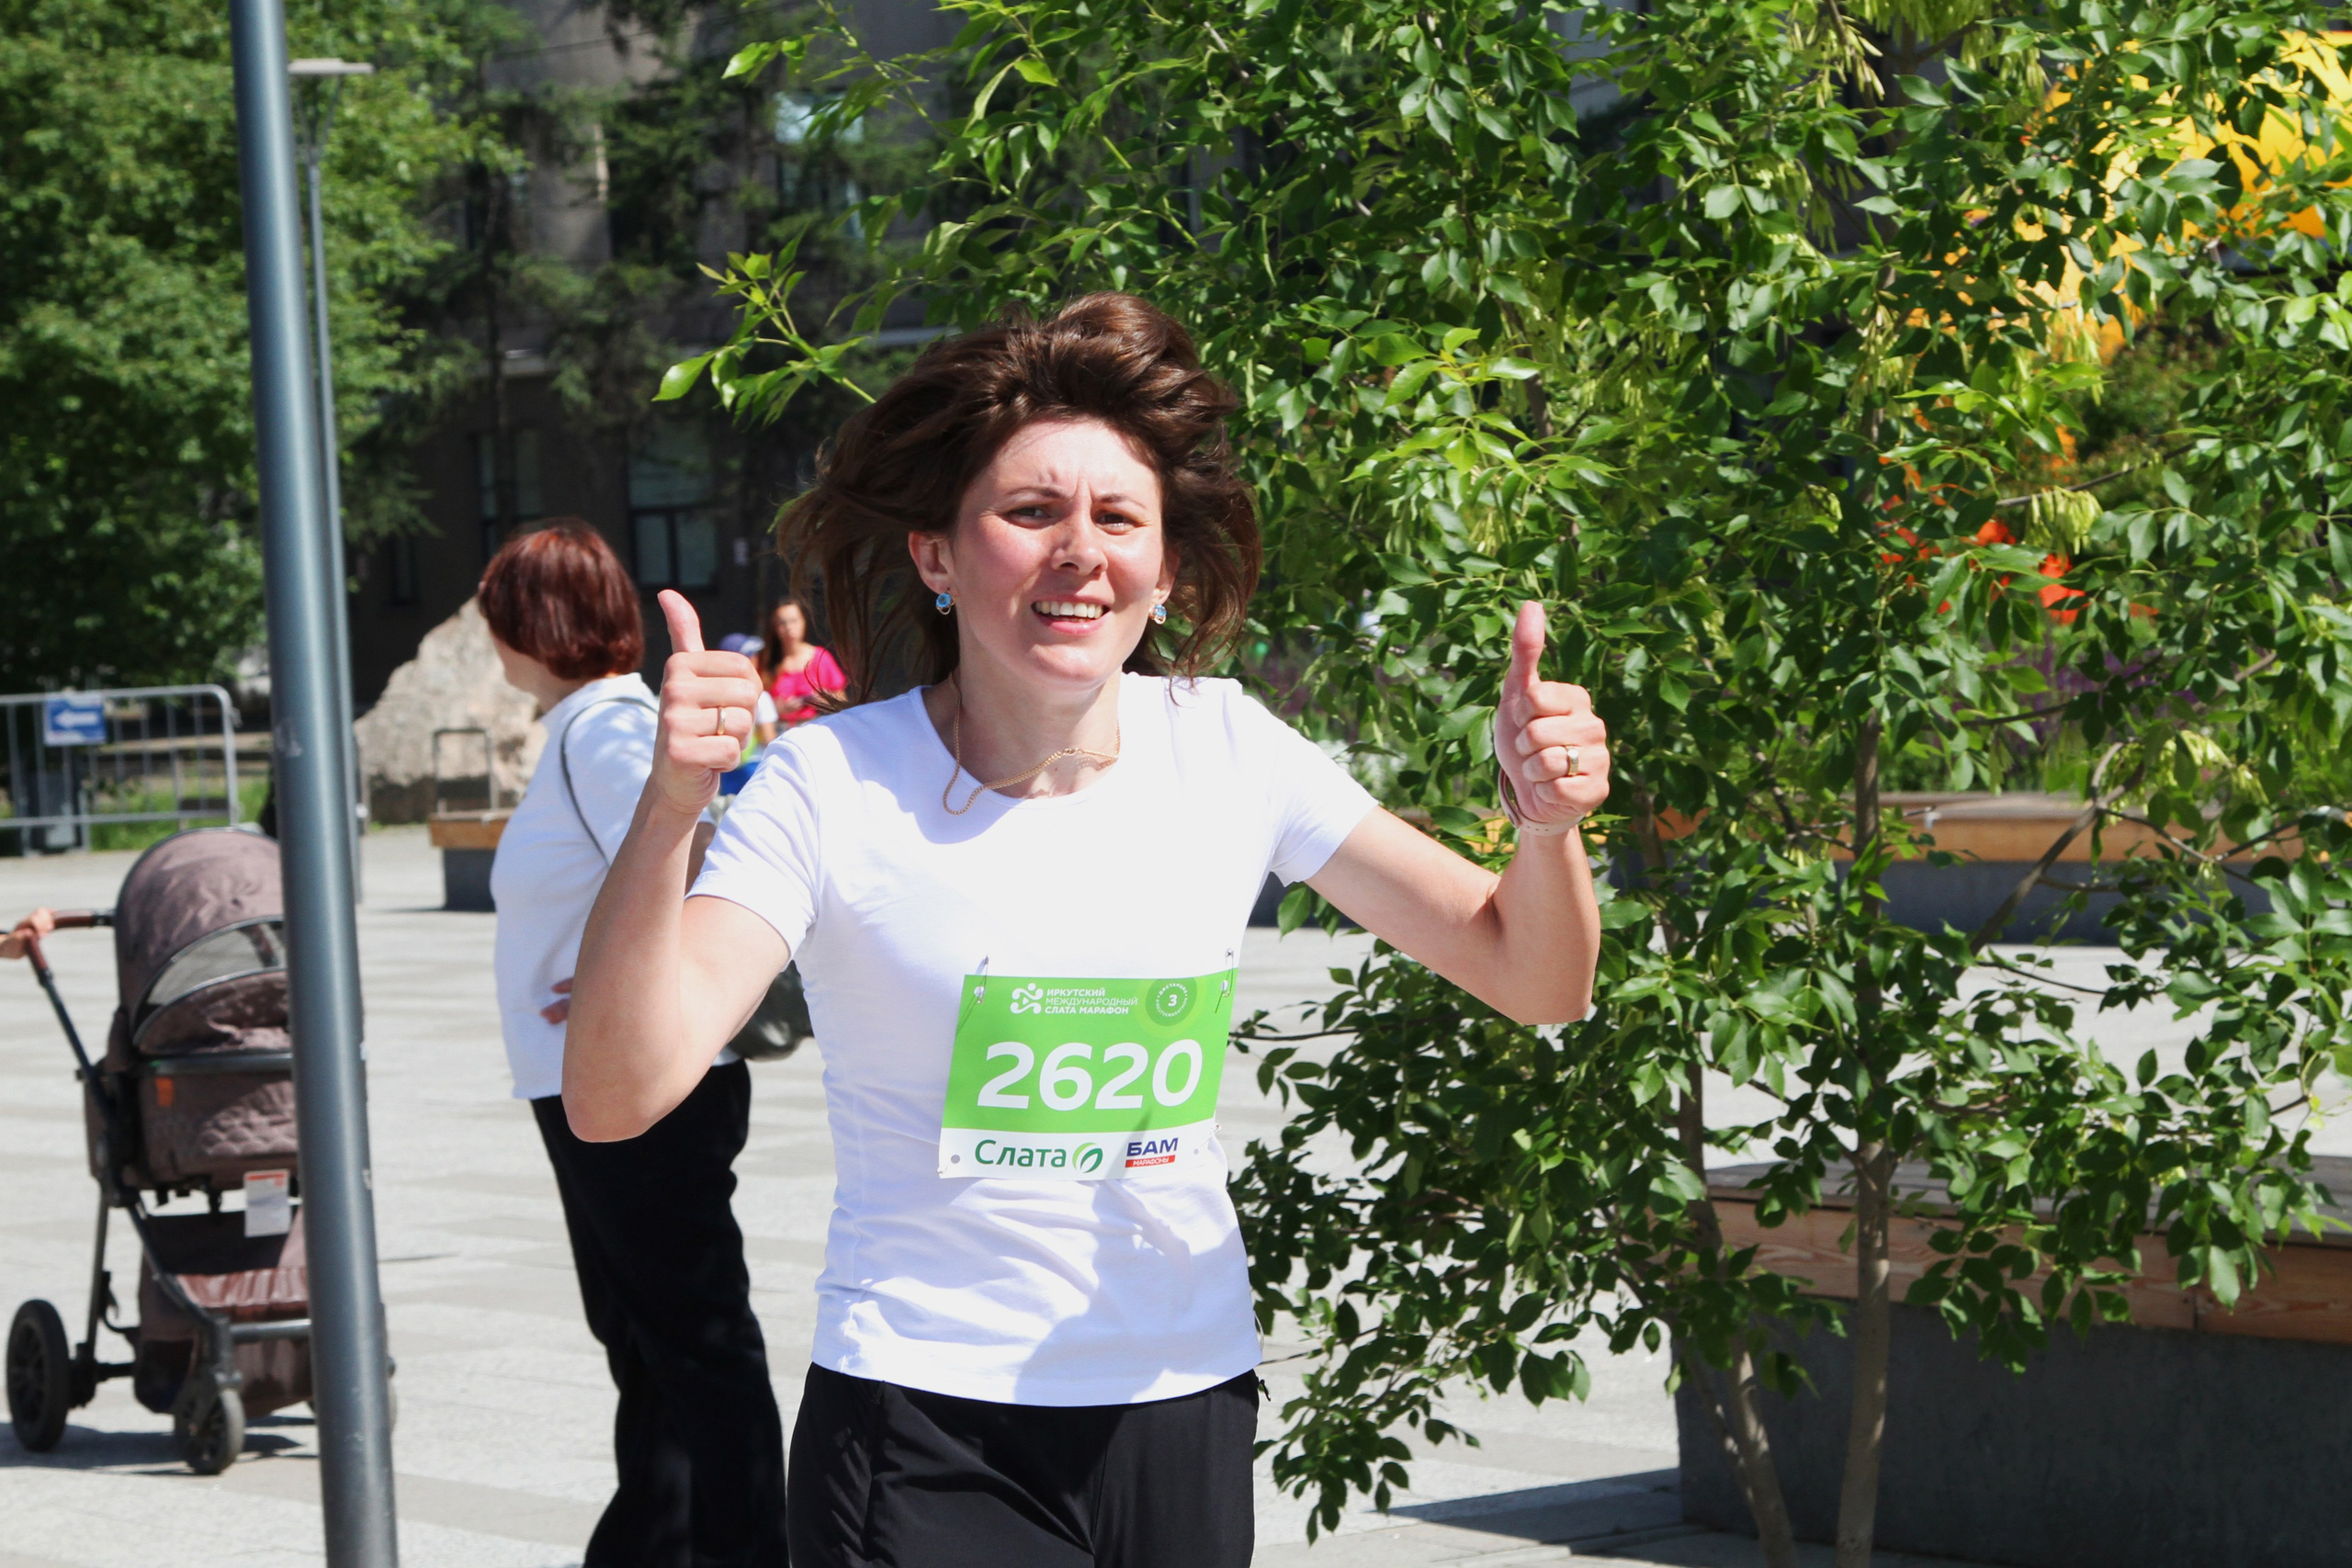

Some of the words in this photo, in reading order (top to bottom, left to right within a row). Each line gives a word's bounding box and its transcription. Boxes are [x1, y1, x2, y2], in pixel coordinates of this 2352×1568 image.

[1046, 987, 1106, 997] ИРКУТСКИЙ
[1046, 997, 1138, 1007] МЕЖДУНАРОДНЫЙ
[1167, 994, 1178, 1007] 3
[1045, 1006, 1077, 1014] СЛАТА
[1079, 1006, 1129, 1015] МАРАФОН
[977, 1039, 1203, 1111] 2620
[1126, 1137, 1179, 1156] БАМ
[975, 1139, 1067, 1168] Слата
[1132, 1156, 1170, 1167] МАРАФОНЫ
